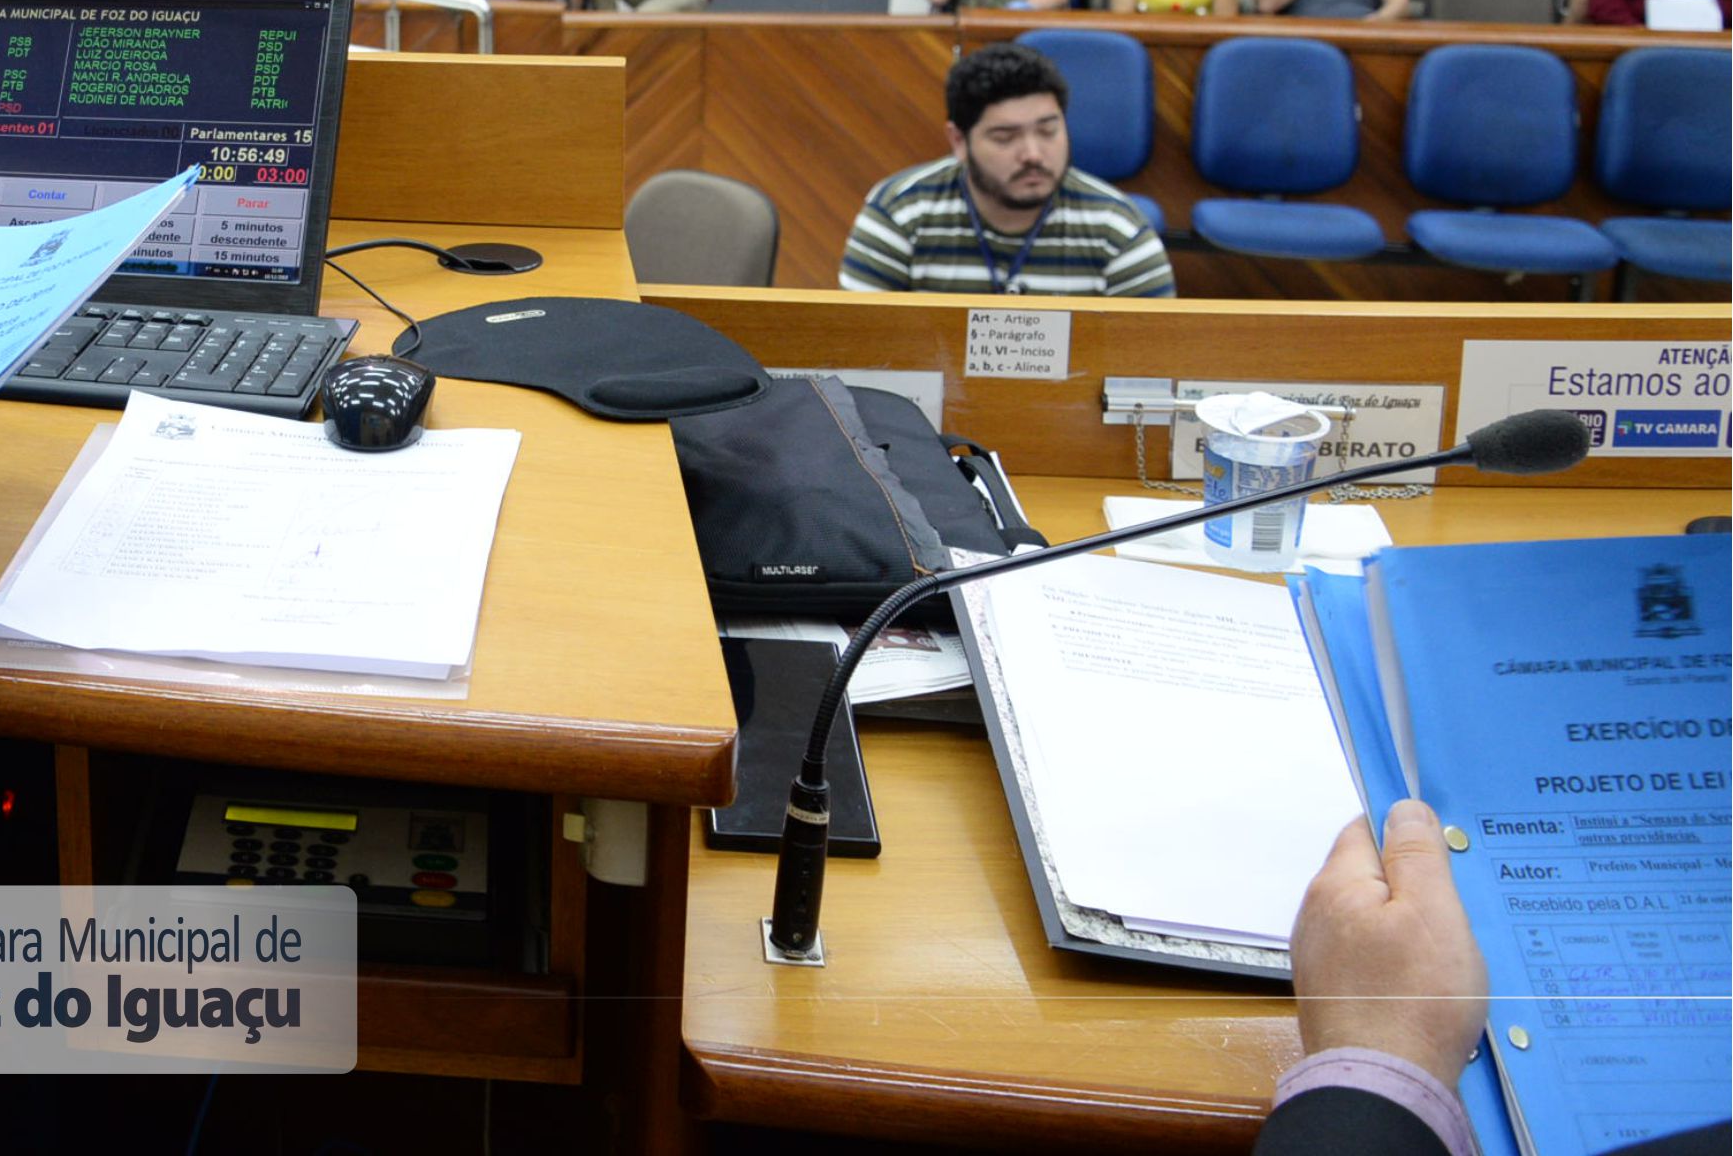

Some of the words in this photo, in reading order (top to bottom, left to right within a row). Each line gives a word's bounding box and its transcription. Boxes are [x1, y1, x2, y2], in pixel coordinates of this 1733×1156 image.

[10, 7, 76, 20] MUNICIPAL
[80, 9, 97, 21] DE
[100, 9, 125, 21] FOZ
[129, 10, 148, 22] DO
[152, 10, 200, 24] IGUAÇU
[79, 28, 141, 38] JEFERSON
[144, 28, 200, 39] BRAYNER
[9, 36, 32, 47] PSB
[77, 37, 110, 49] JOÃO
[112, 38, 166, 49] MIRANDA
[258, 41, 283, 52] PSD
[7, 47, 31, 58] PDT
[75, 49, 101, 60] LUIZ
[104, 50, 167, 61] QUEIROGA
[257, 52, 284, 63] DEM
[74, 60, 121, 71] MARCIO
[124, 61, 157, 72] ROSA
[255, 64, 280, 75] PSD
[3, 69, 27, 80] PSC
[72, 71, 109, 83] NANCI
[126, 73, 191, 85] ANDREOLA
[253, 75, 278, 86] PDT
[1, 81, 24, 91] PTB
[129, 84, 190, 95] QUADROS
[252, 86, 276, 97] PTB
[0, 91, 14, 102] PL
[68, 94, 117, 105] RUDINEI
[120, 95, 136, 106] DE
[139, 95, 184, 107] MOURA
[38, 122, 55, 135] 01
[190, 127, 287, 142] Parlamentares
[294, 130, 312, 144] 15
[211, 146, 286, 164] 10:56:49
[188, 165, 234, 182] 0:00
[257, 167, 307, 184] 03:00
[28, 189, 66, 201] Contar
[237, 197, 270, 209] Parar
[221, 221, 228, 231] 5
[235, 221, 284, 234] minutos
[210, 234, 288, 248] descendente
[214, 250, 227, 261] 15
[231, 251, 280, 263] minutos
[971, 313, 990, 323] Art
[1004, 314, 1041, 327] Artigo
[988, 329, 1046, 342] Parágrafo
[995, 345, 1008, 355] VI
[1021, 347, 1055, 357] Inciso
[1659, 345, 1732, 369] ATENÇÃ
[997, 363, 1004, 372] c
[1549, 366, 1682, 396] Estamos
[1694, 373, 1731, 397] ao
[1322, 396, 1336, 406] de
[1340, 396, 1361, 409] Foz
[1364, 396, 1378, 407] do
[1382, 397, 1421, 409] Iguaçu
[1635, 423, 1654, 434] TV
[1318, 441, 1416, 458] BERATO
[762, 564, 819, 577] MULTILASER
[1494, 658, 1571, 676] CÂMARA
[1574, 656, 1674, 673] MUNICIPAL
[1680, 653, 1706, 669] DE
[1567, 717, 1701, 742] EXERCÍCIO
[1535, 774, 1644, 794] PROJETO
[1650, 772, 1682, 792] DE
[1688, 771, 1726, 790] LEI
[1481, 818, 1565, 836] Ementa:
[1499, 863, 1561, 880] Autor:
[1588, 860, 1637, 872] Prefeito
[1640, 859, 1701, 874] Municipal
[1507, 896, 1583, 913] Recebido
[1586, 895, 1621, 914] pela
